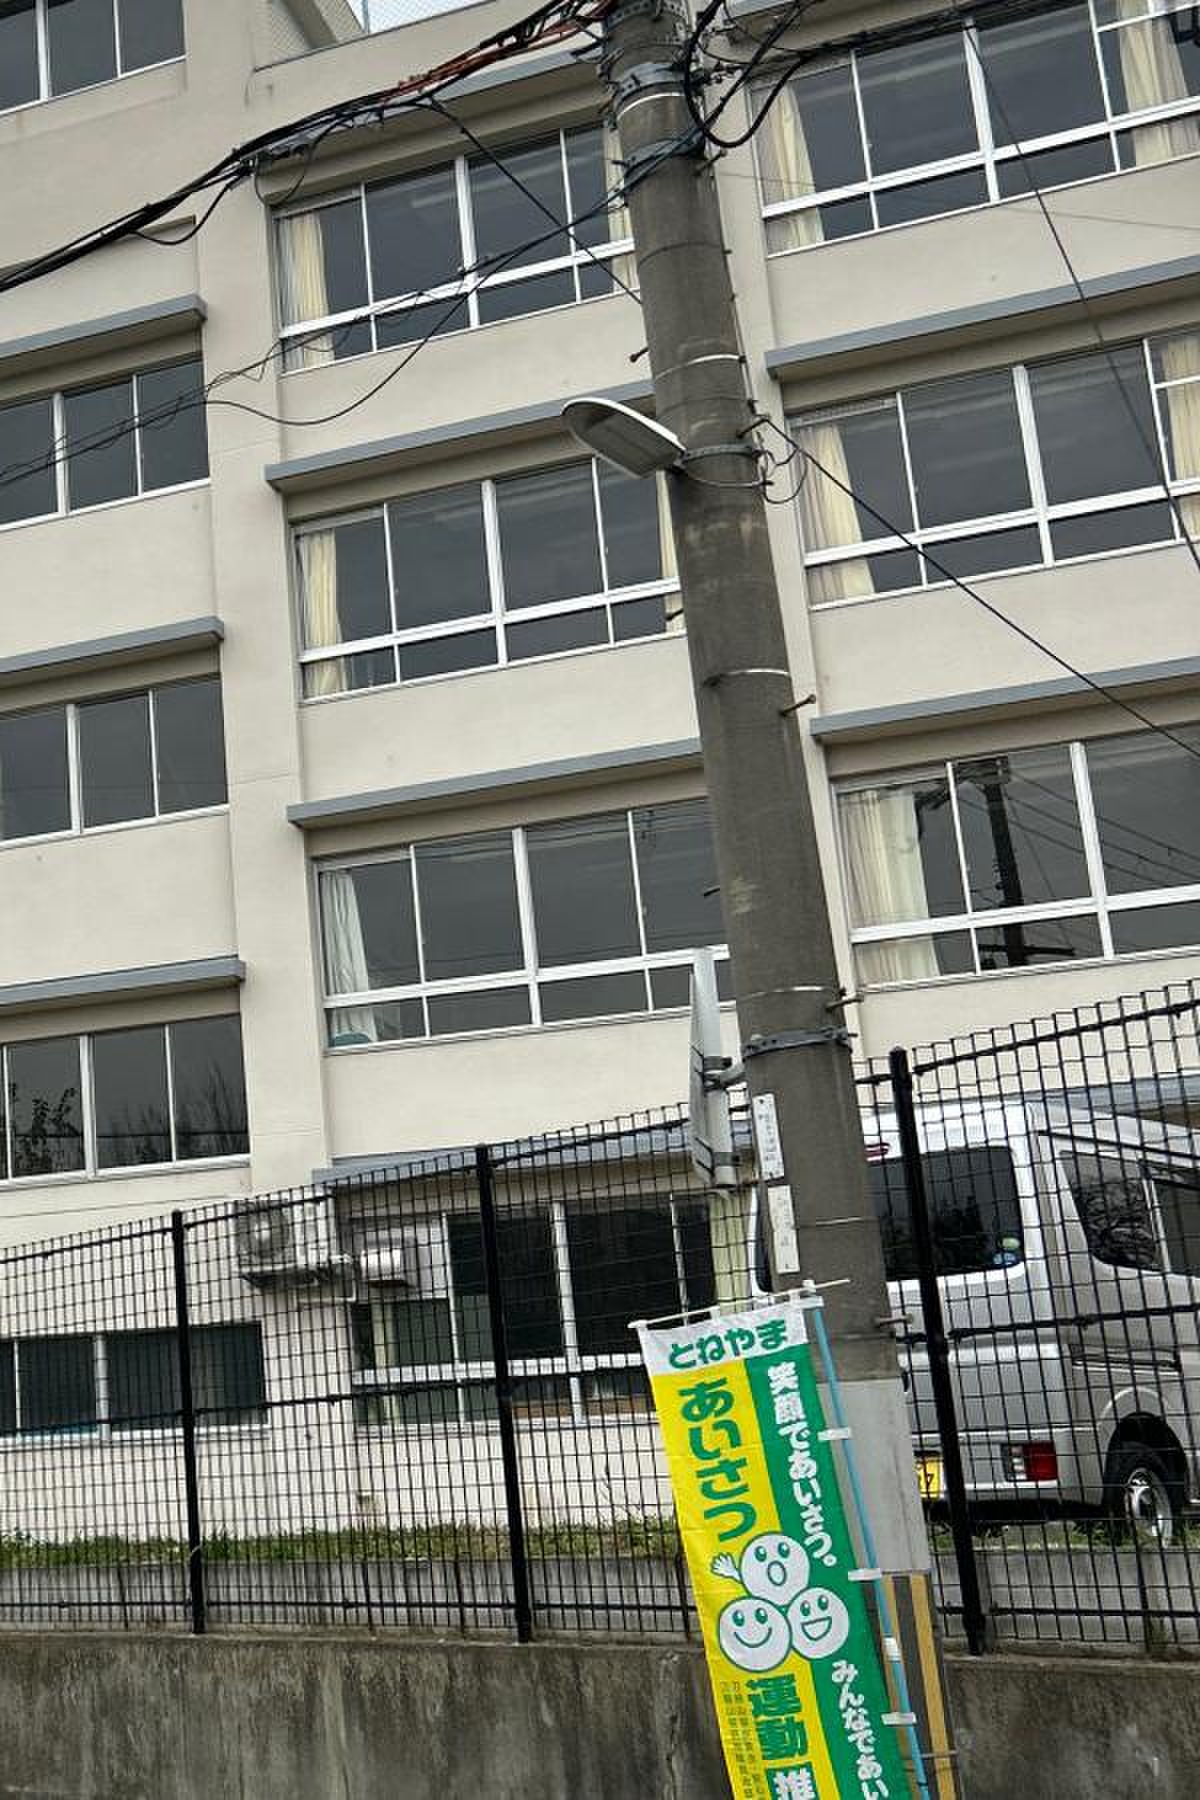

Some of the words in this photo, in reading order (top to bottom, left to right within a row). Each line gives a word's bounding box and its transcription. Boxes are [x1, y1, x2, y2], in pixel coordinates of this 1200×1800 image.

[668, 1319, 786, 1369] とねやま
[678, 1377, 757, 1542] あいさつ
